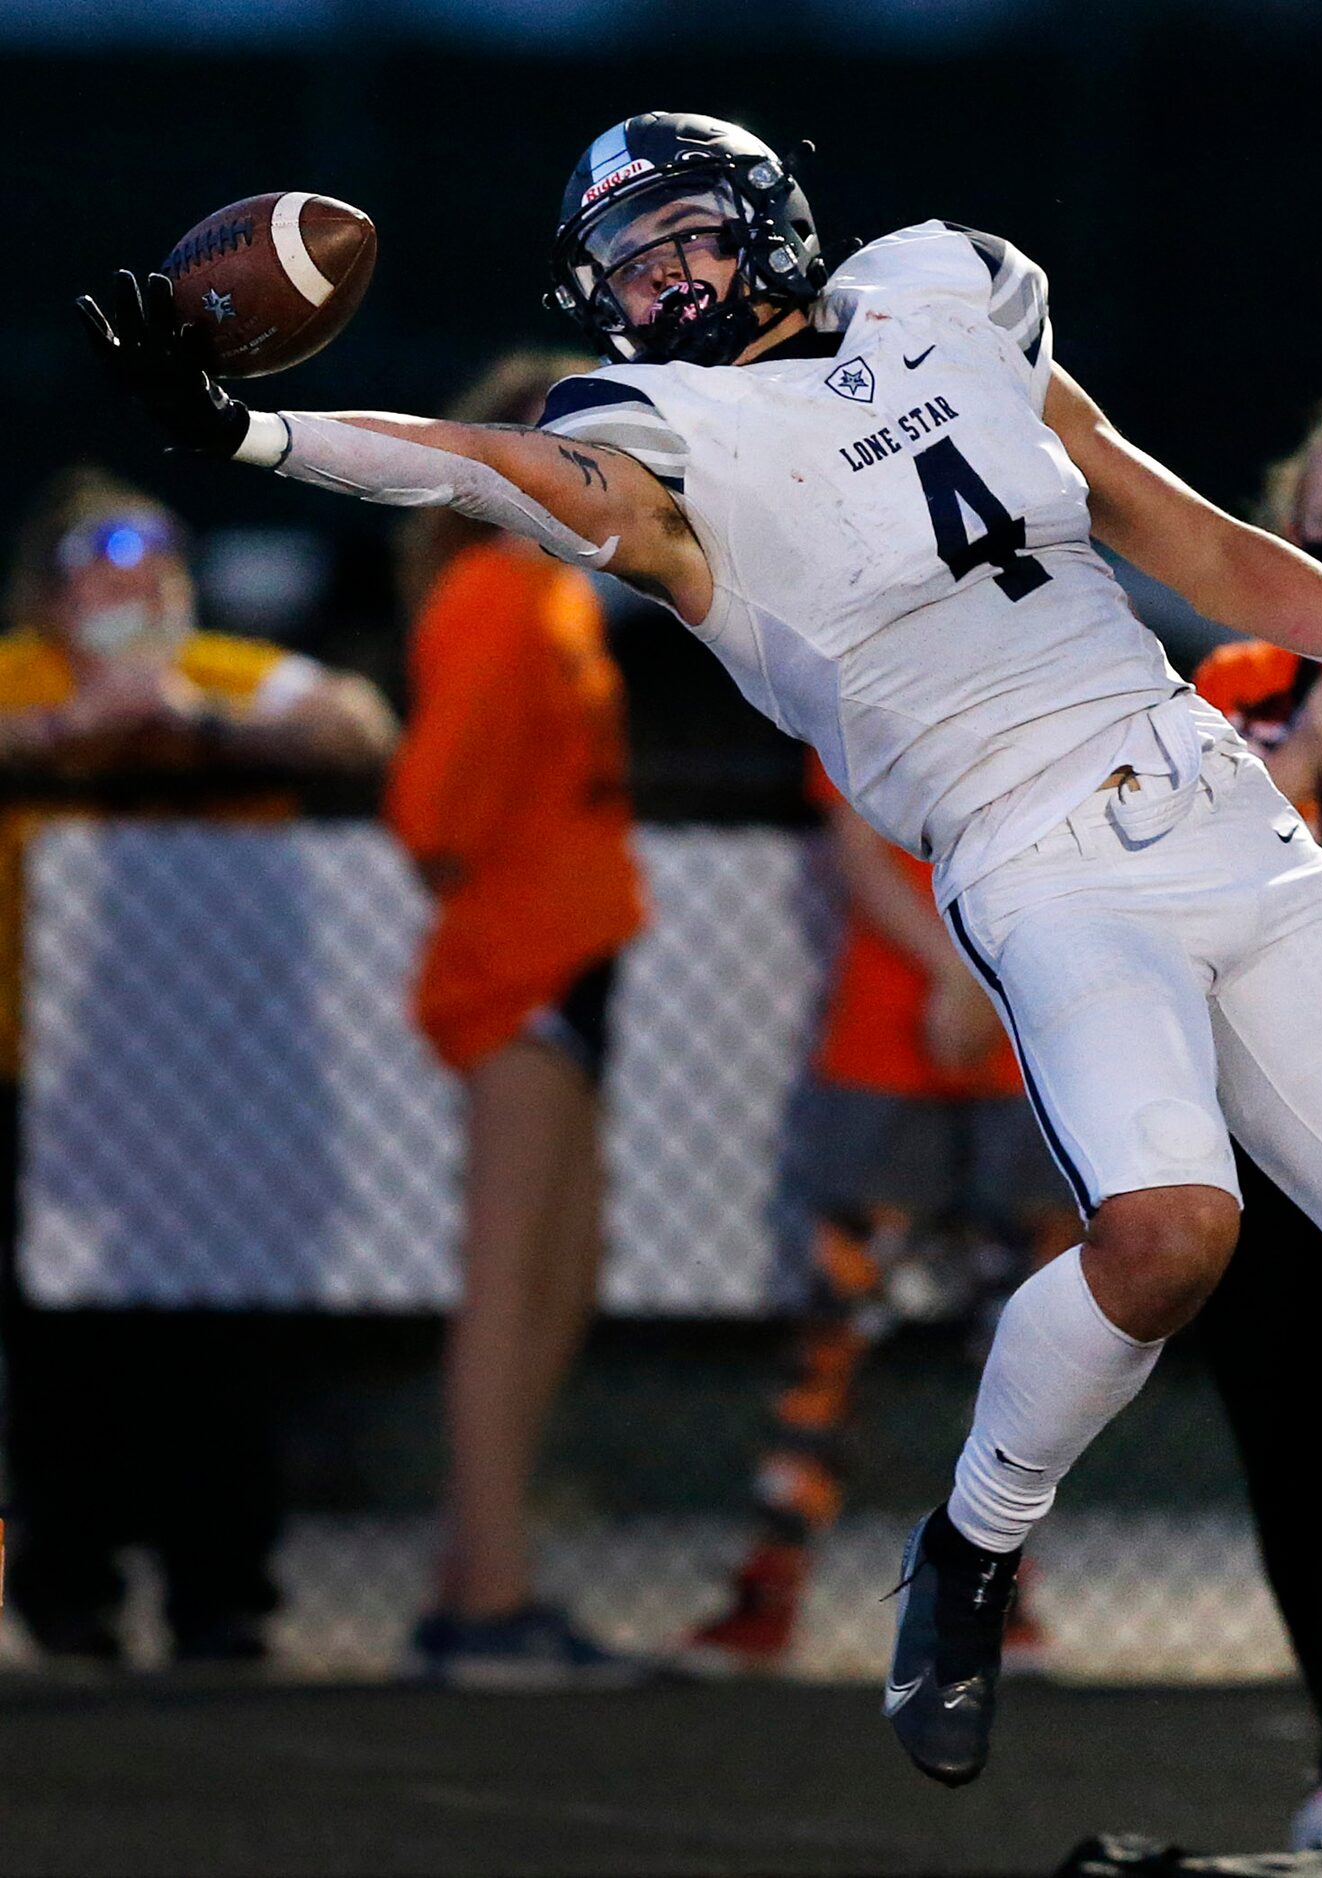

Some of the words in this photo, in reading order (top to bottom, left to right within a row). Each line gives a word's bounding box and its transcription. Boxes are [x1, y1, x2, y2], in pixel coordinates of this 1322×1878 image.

[839, 427, 901, 472] LONE
[898, 396, 959, 441] STAR
[913, 435, 1053, 602] 4
